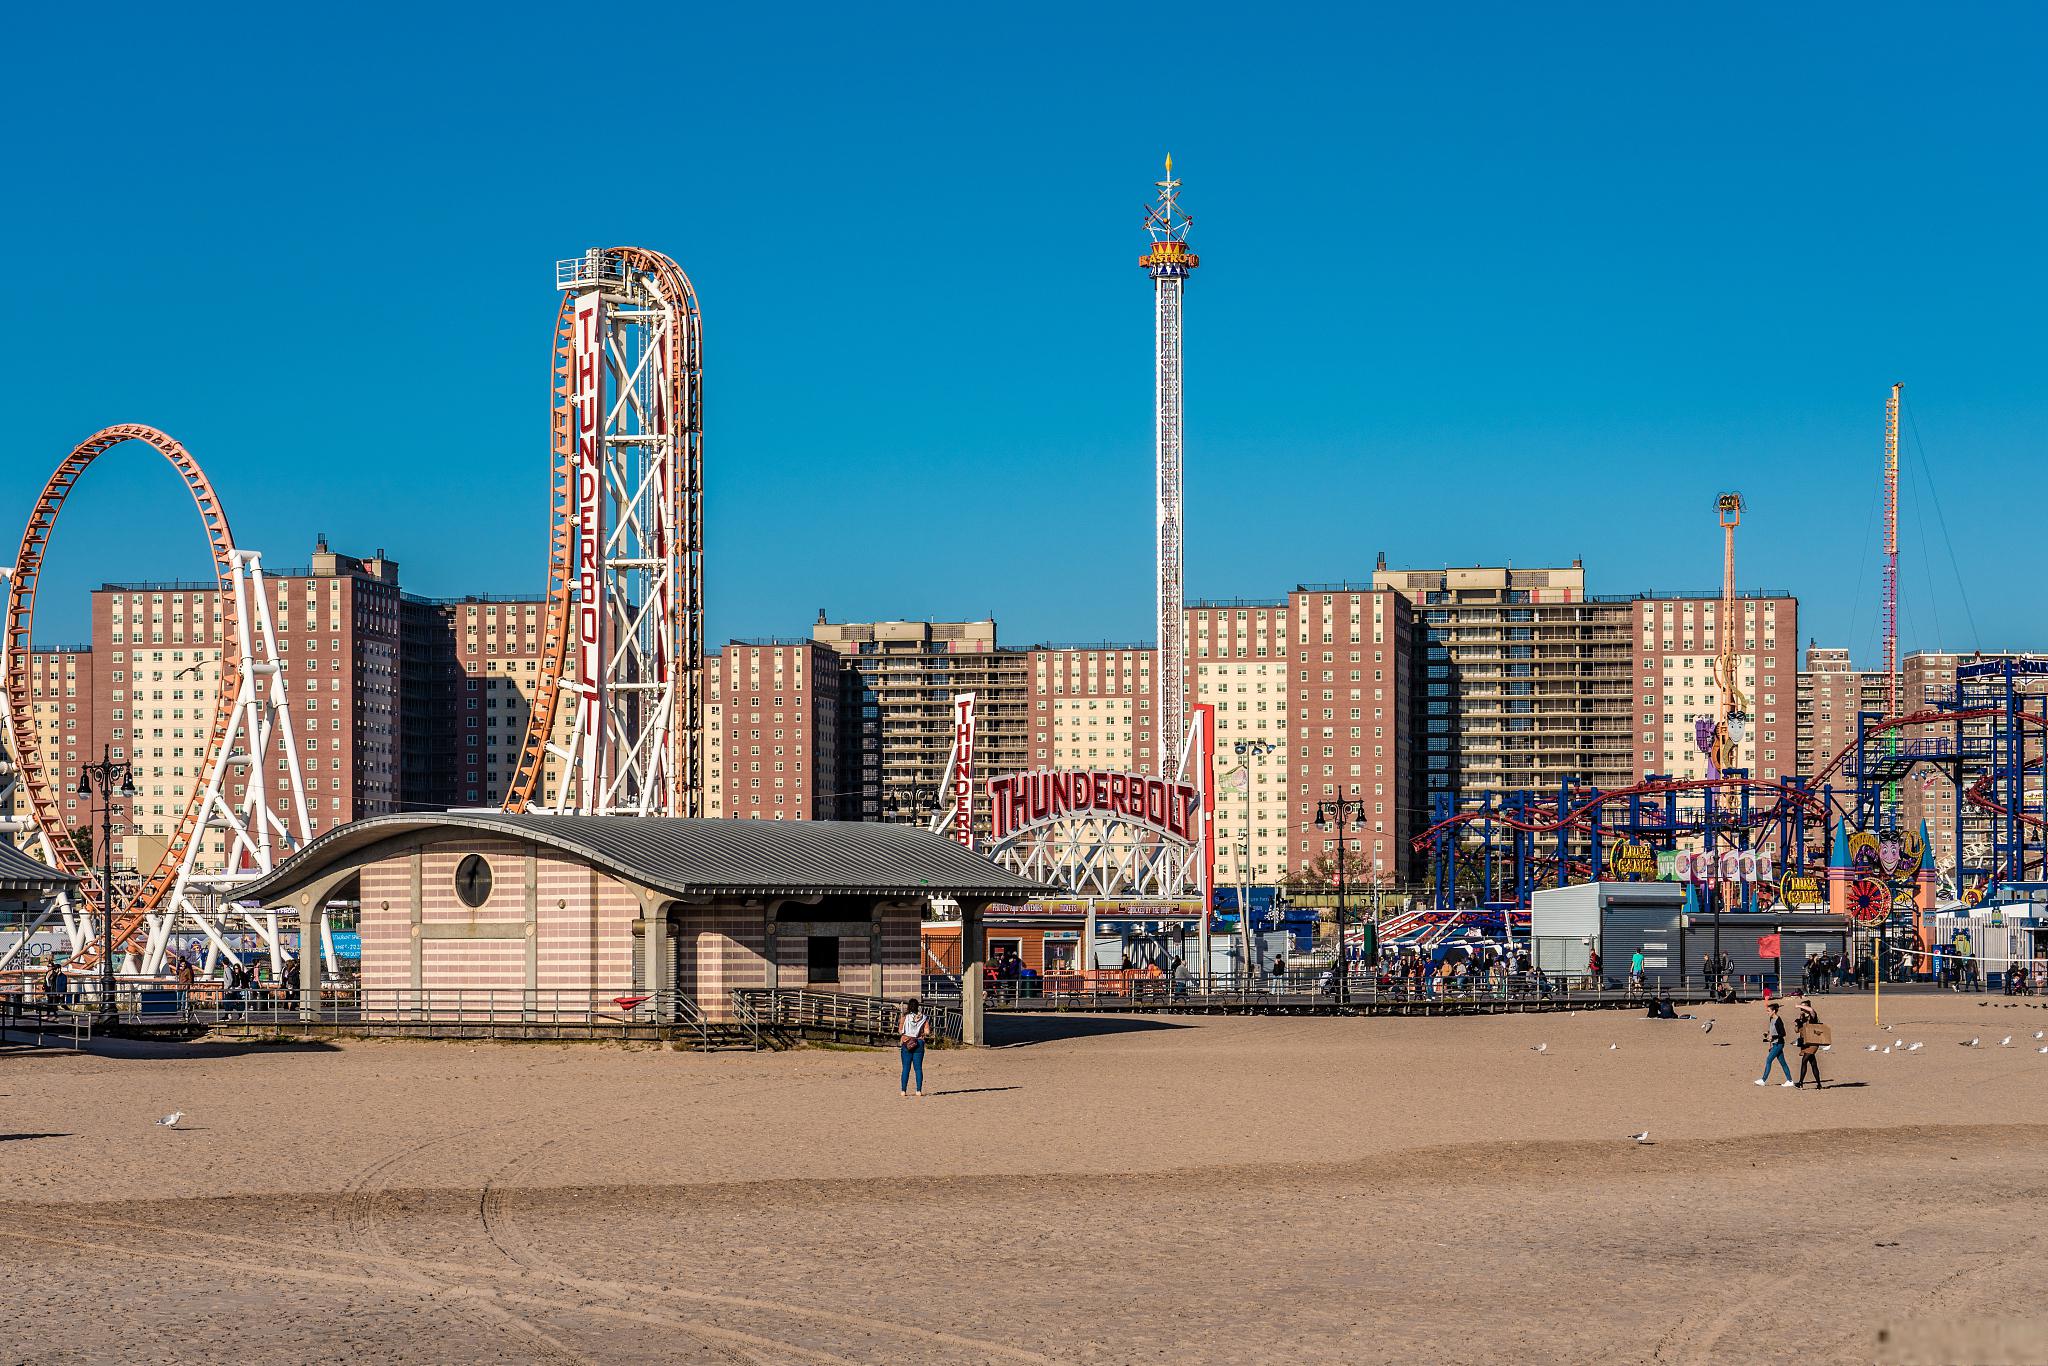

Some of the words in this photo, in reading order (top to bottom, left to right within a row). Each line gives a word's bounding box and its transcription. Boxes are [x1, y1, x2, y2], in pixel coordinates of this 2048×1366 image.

[578, 308, 598, 736] THUNDERBOLT
[955, 701, 971, 846] THUNDERB
[988, 769, 1198, 843] THUNDERBOLT
